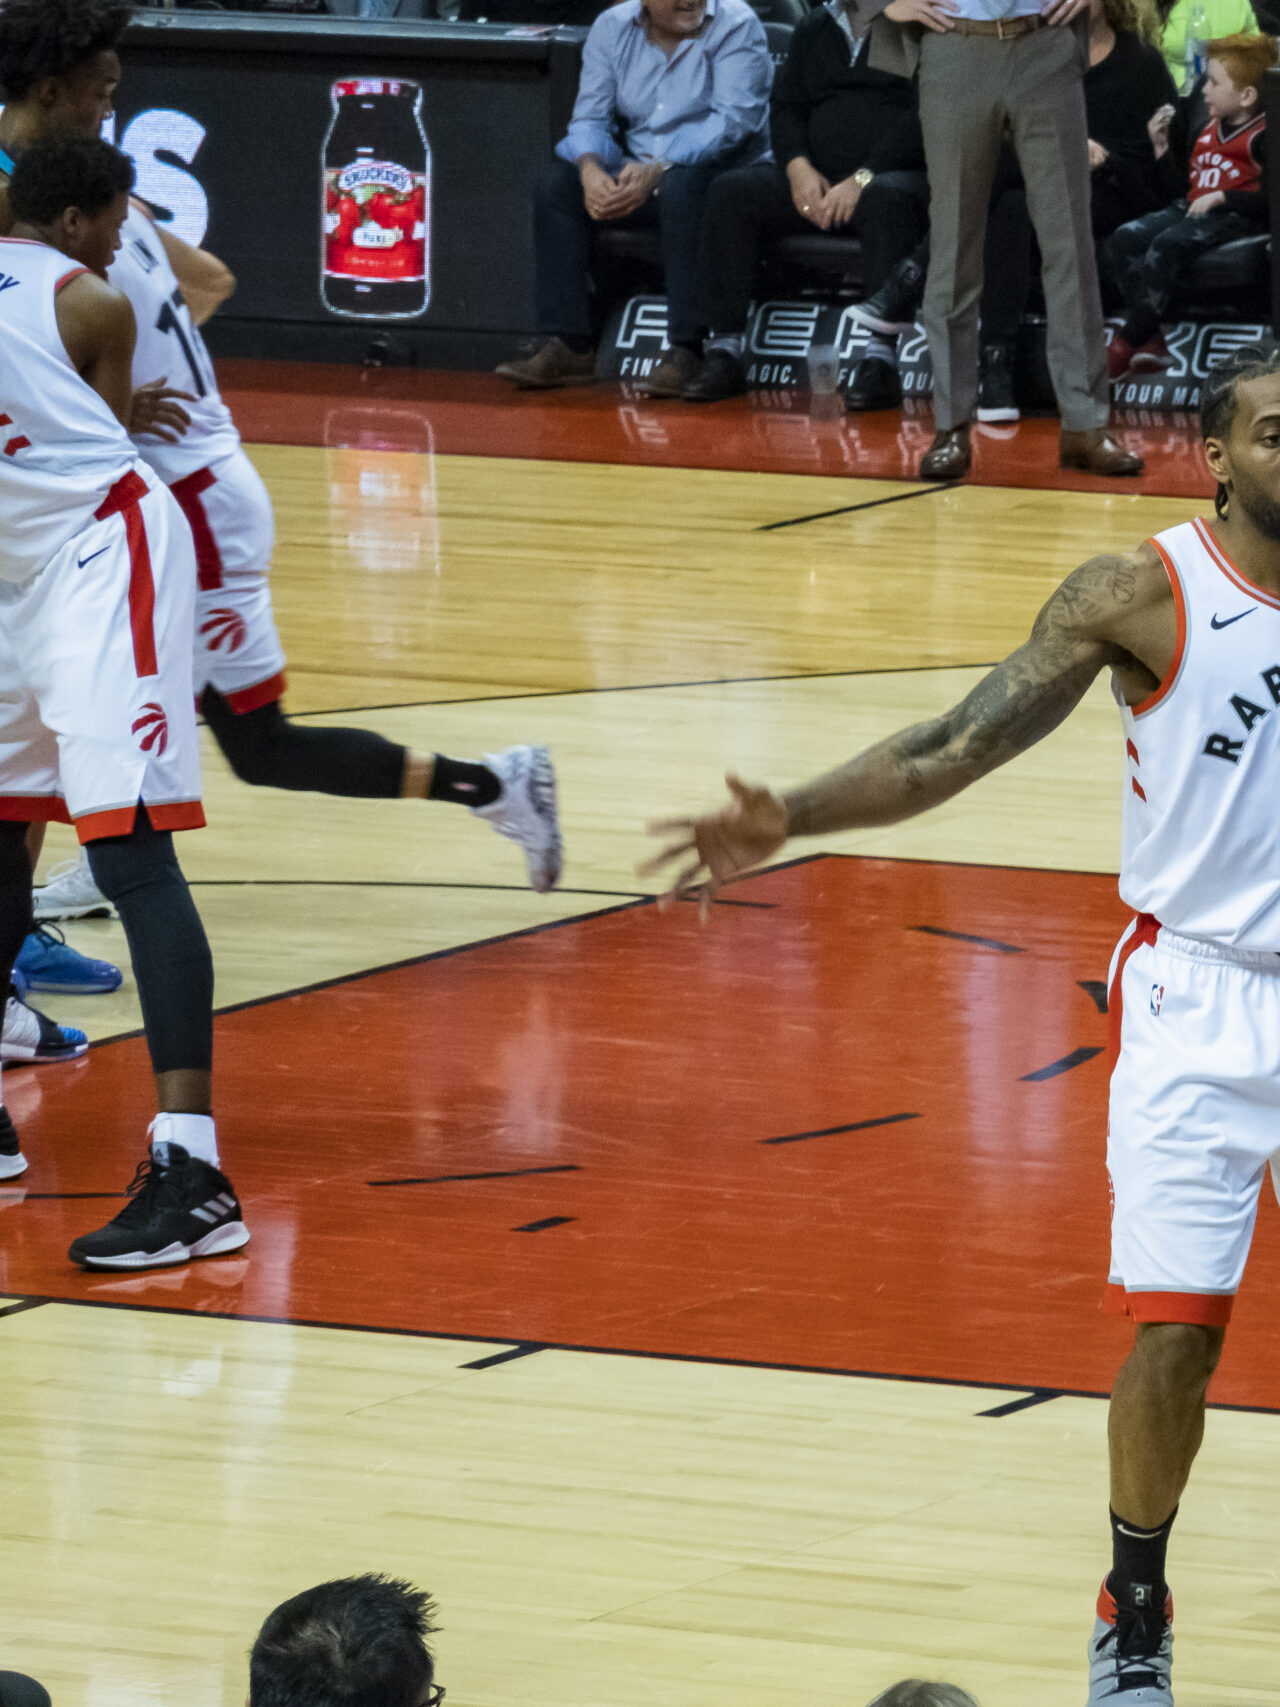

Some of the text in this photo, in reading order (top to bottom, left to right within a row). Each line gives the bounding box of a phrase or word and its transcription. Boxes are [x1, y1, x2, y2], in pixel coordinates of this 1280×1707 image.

[1198, 167, 1220, 189] 10
[619, 356, 797, 385] FIN AGIC.
[1114, 383, 1162, 405] YOUR
